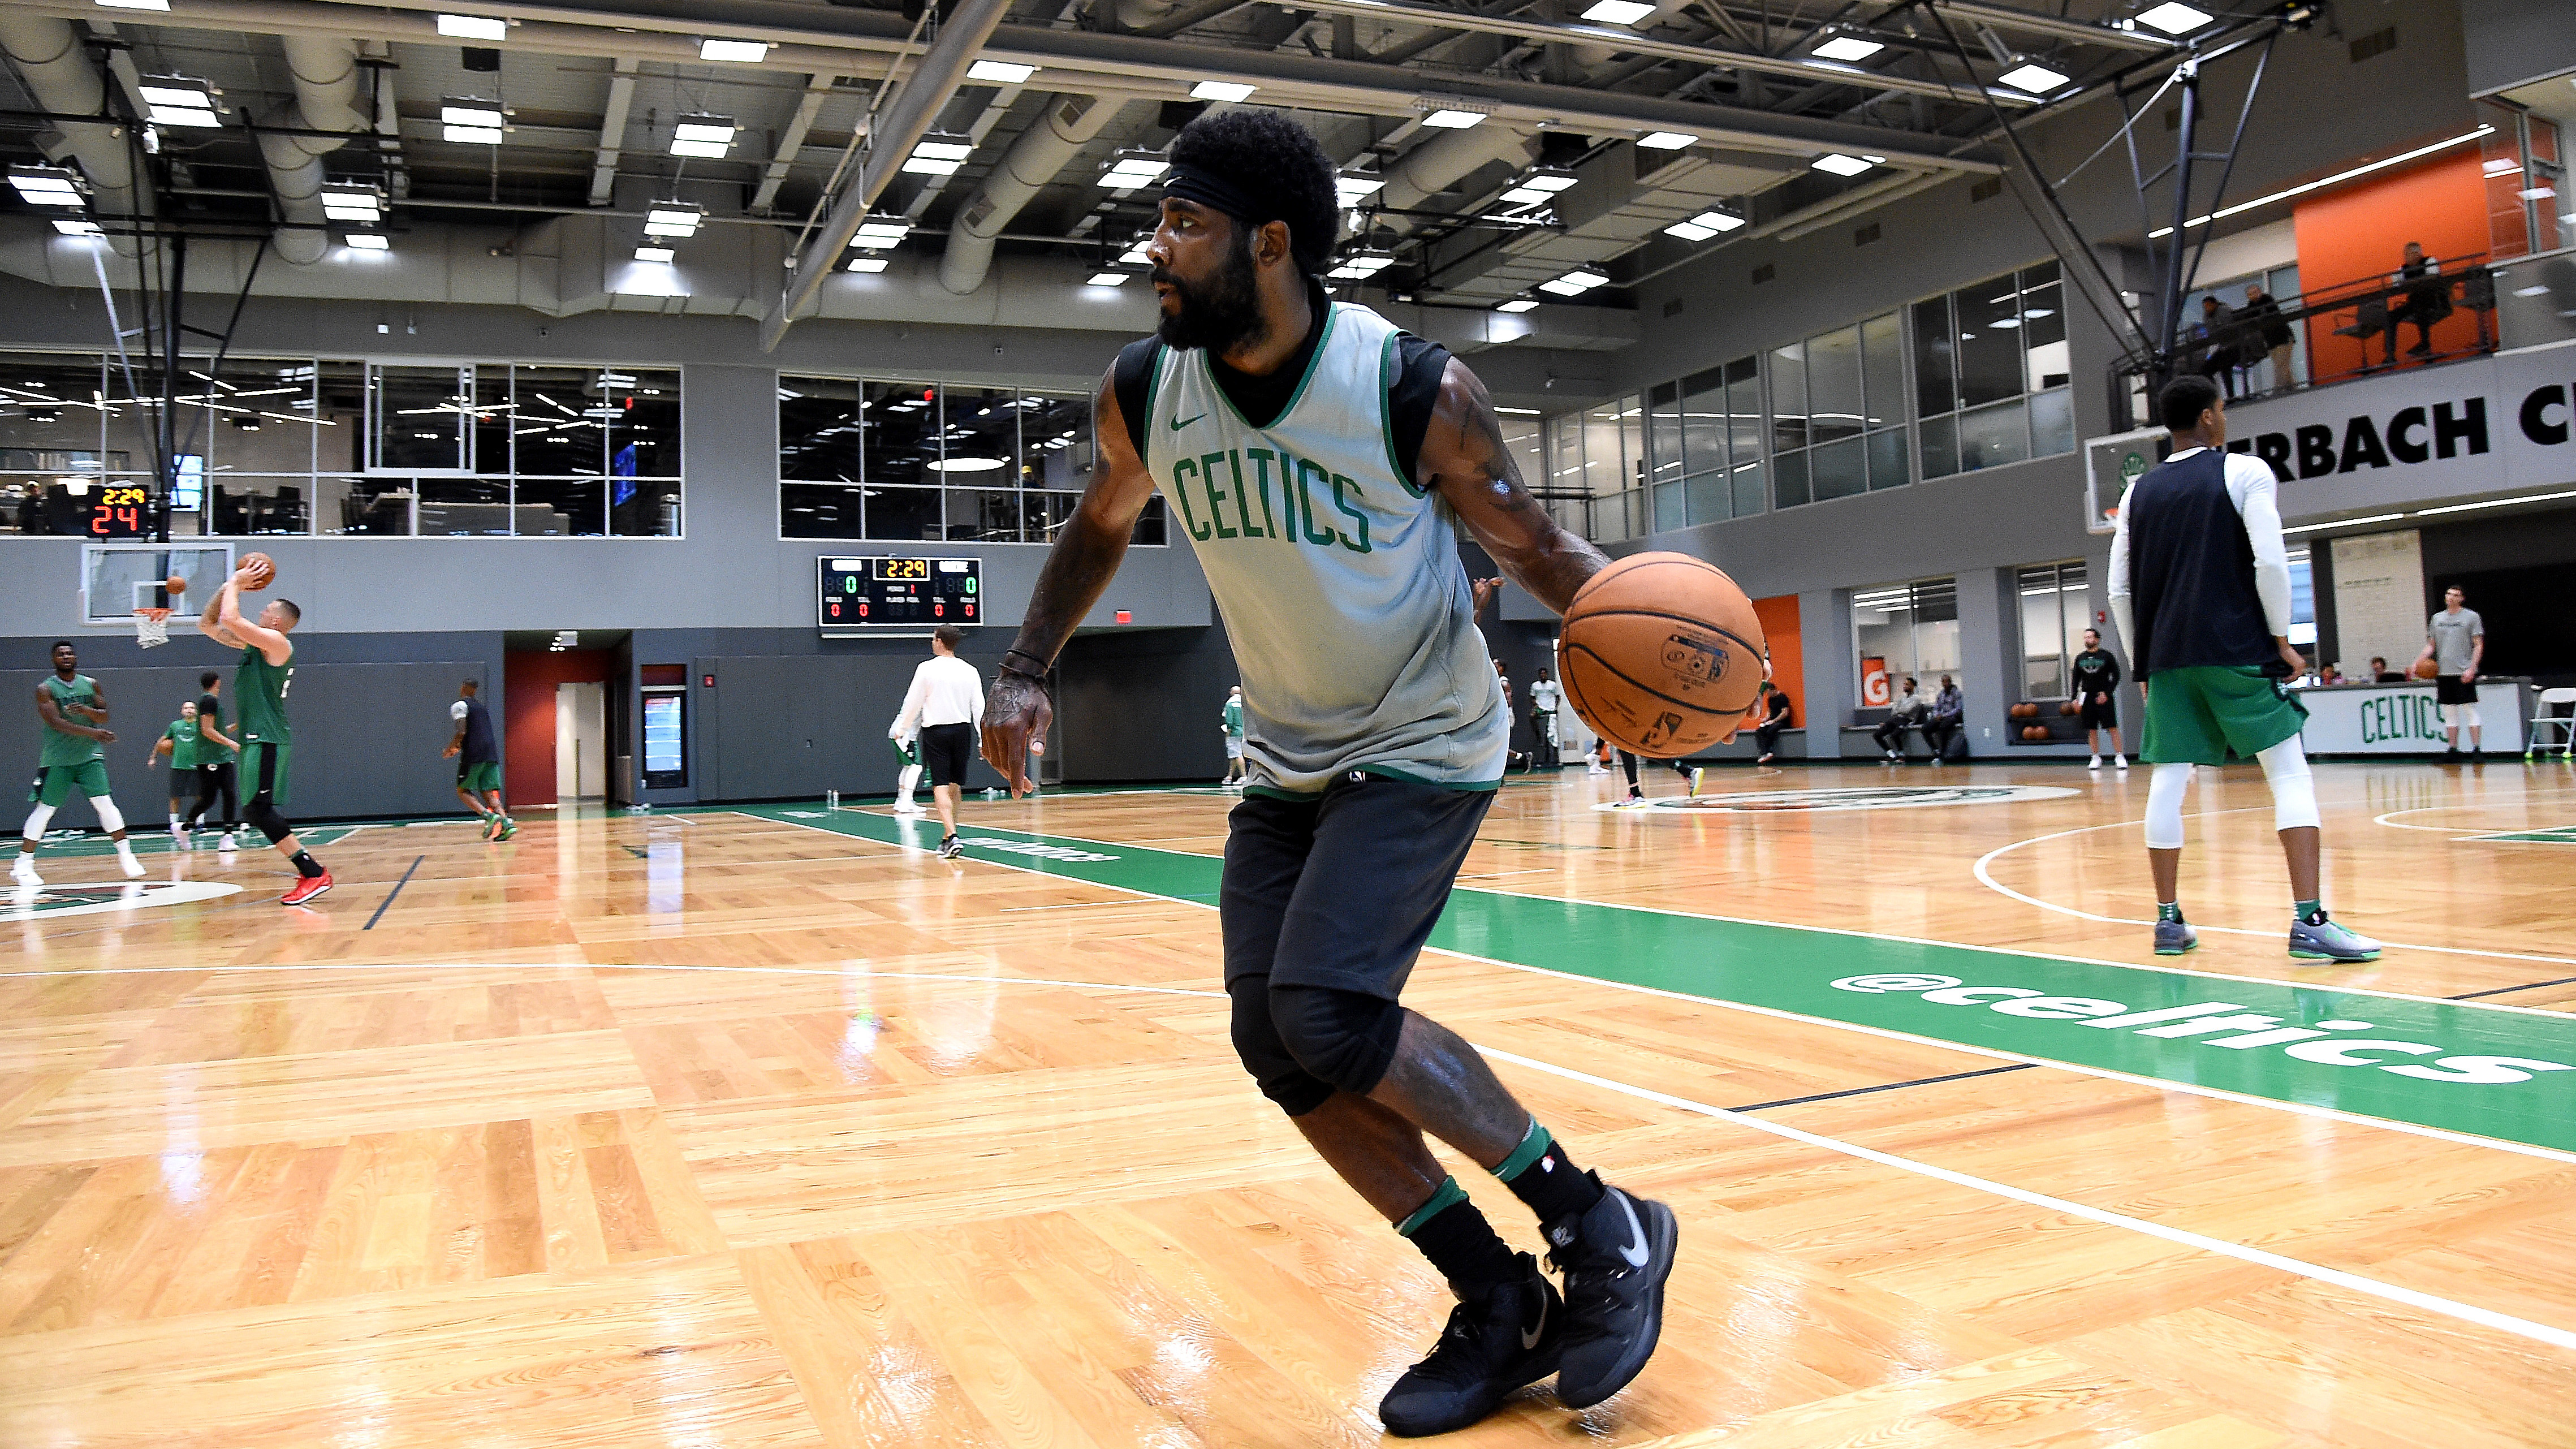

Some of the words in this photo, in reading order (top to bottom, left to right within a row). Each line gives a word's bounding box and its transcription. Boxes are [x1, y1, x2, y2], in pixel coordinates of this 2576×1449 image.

[2519, 382, 2576, 446] C
[102, 489, 145, 505] 2:29
[1172, 448, 1373, 554] CELTICS
[92, 506, 137, 533] 24
[887, 560, 925, 577] 2:29
[845, 576, 857, 593] 0
[911, 584, 916, 594] 1
[965, 577, 977, 594] 0
[1865, 669, 1888, 702] G
[1829, 972, 2576, 1085] @celtics
